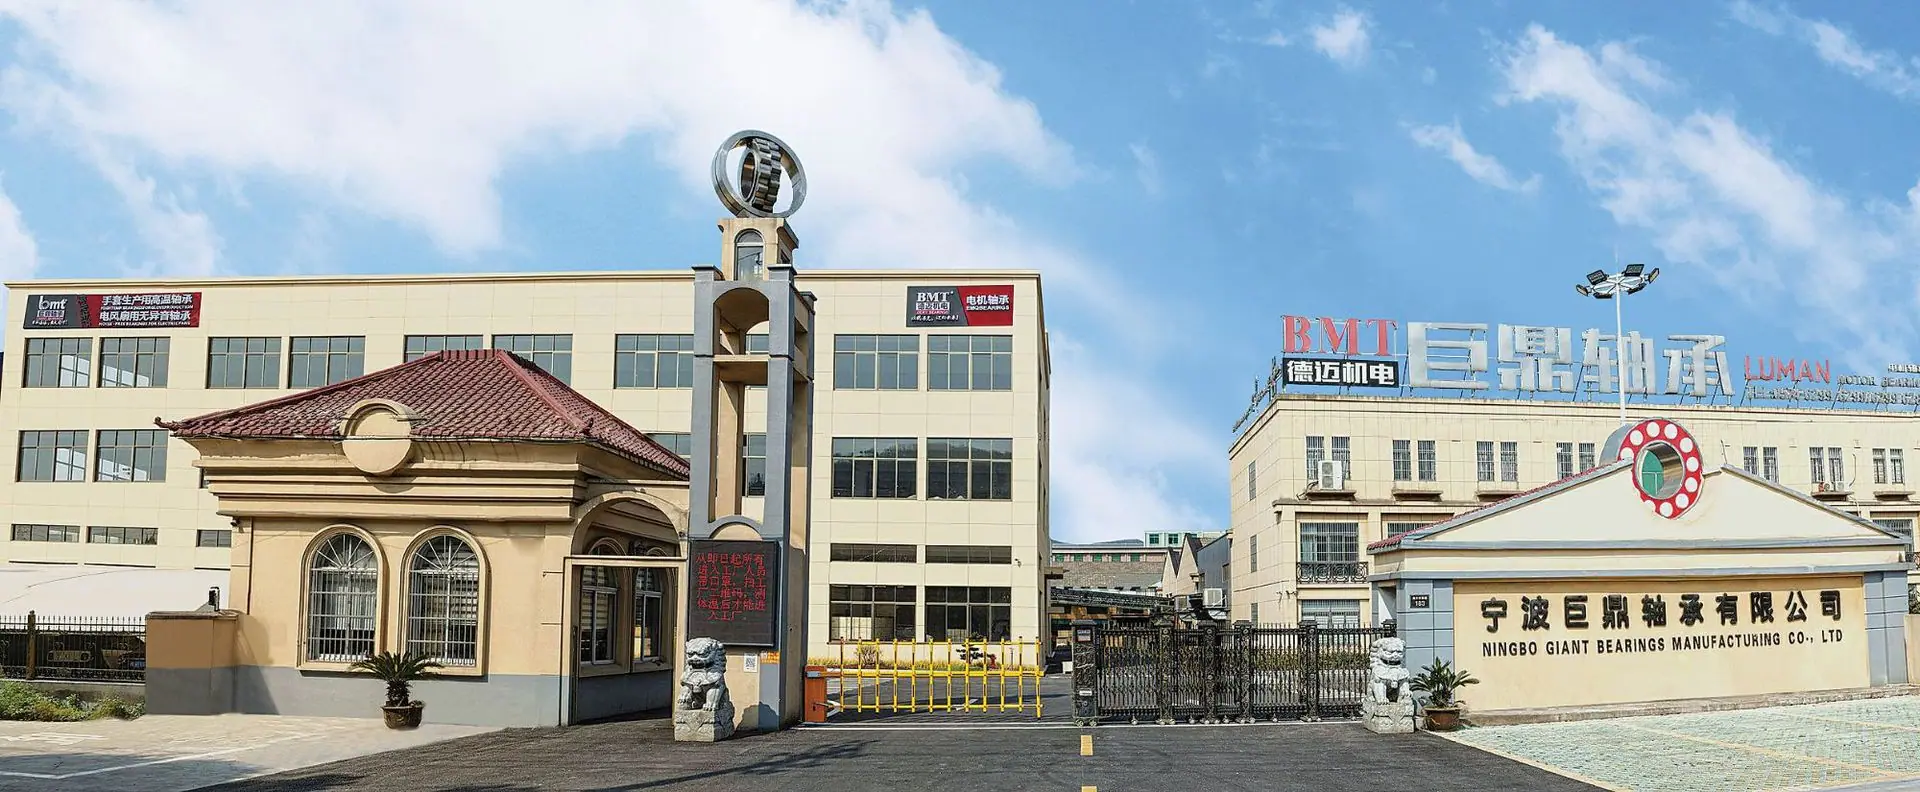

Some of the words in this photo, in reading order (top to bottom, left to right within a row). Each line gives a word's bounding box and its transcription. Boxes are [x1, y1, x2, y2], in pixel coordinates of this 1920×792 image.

[101, 294, 193, 306] 手套生产用高温轴承
[917, 291, 950, 302] BMT
[966, 294, 1009, 305] 电机轴承
[99, 310, 191, 322] 电风扇用无异音轴承
[1282, 315, 1398, 357] BMT
[1407, 321, 1735, 397] 巨鼎轴承
[1744, 355, 1831, 384] LUMAN
[1287, 360, 1395, 386] 德迈机电
[1481, 591, 1841, 633] 宁波巨鼎轴承有限公司
[1482, 641, 1538, 657] NINGBO
[1545, 639, 1590, 655] GIANT
[1597, 637, 1665, 654] BEARINGS
[1672, 632, 1781, 651] MANUFACTURING
[1821, 629, 1843, 643] LTD
